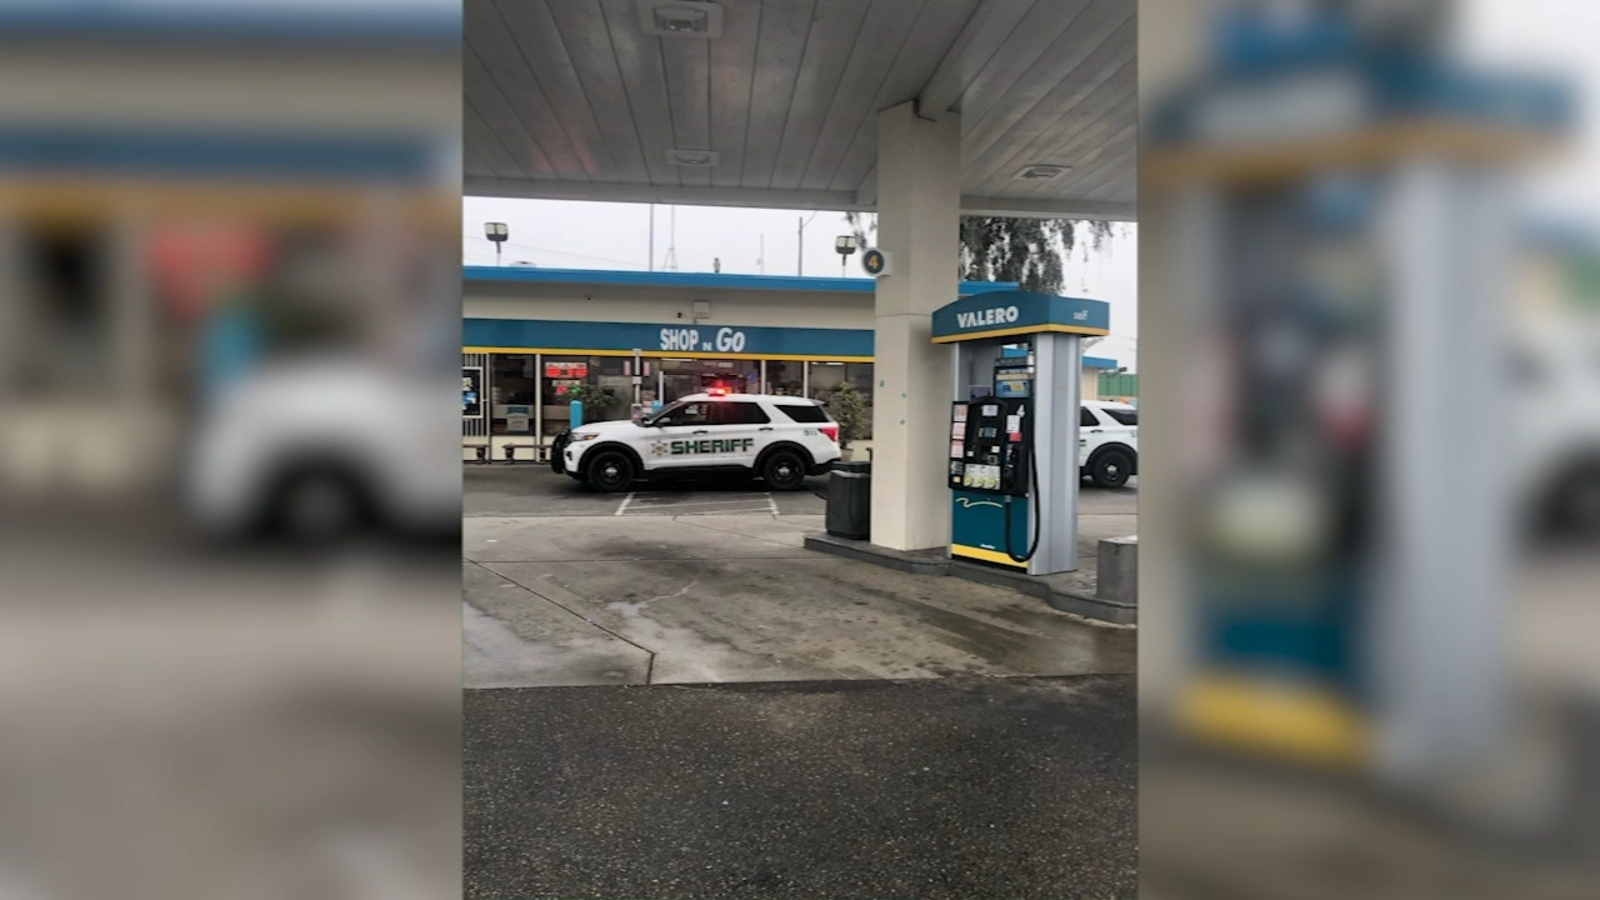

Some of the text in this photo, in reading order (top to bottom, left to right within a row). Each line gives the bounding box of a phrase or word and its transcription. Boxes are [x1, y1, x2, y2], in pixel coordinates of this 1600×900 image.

[868, 254, 879, 270] 4
[957, 305, 1019, 329] VALERO
[660, 327, 746, 352] SHOP N Go
[1016, 404, 1026, 418] 4
[670, 438, 755, 455] SHERIFF
